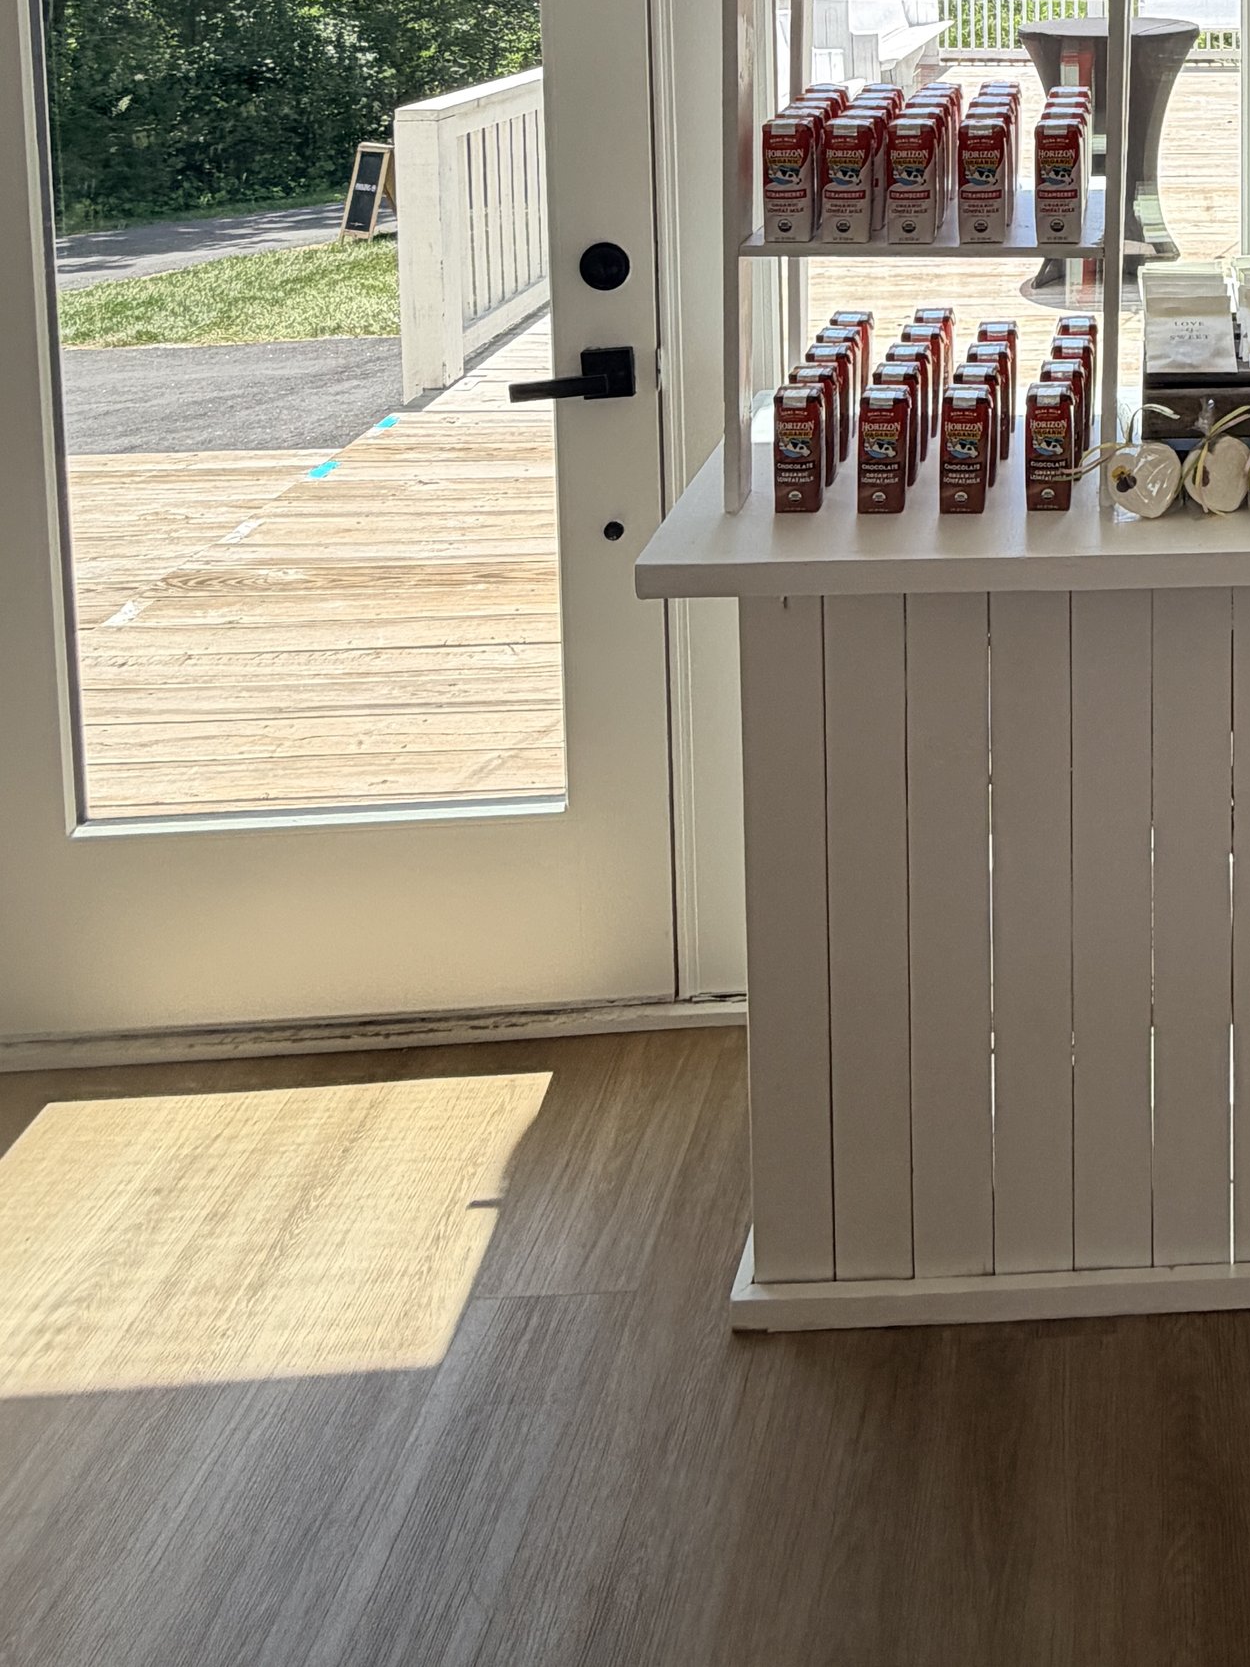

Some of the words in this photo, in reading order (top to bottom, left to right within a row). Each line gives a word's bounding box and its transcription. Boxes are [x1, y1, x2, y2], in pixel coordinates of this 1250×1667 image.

[766, 149, 803, 158] HORIZON
[826, 150, 865, 159] HORIZON
[891, 150, 928, 159] HORIZON
[963, 150, 1000, 159] HORIZON
[1038, 150, 1075, 159] HORIZON
[777, 421, 814, 430] HORIZON
[862, 422, 900, 431] HORIZON
[945, 422, 983, 431] HORIZON
[1030, 420, 1067, 429] HORIZON
